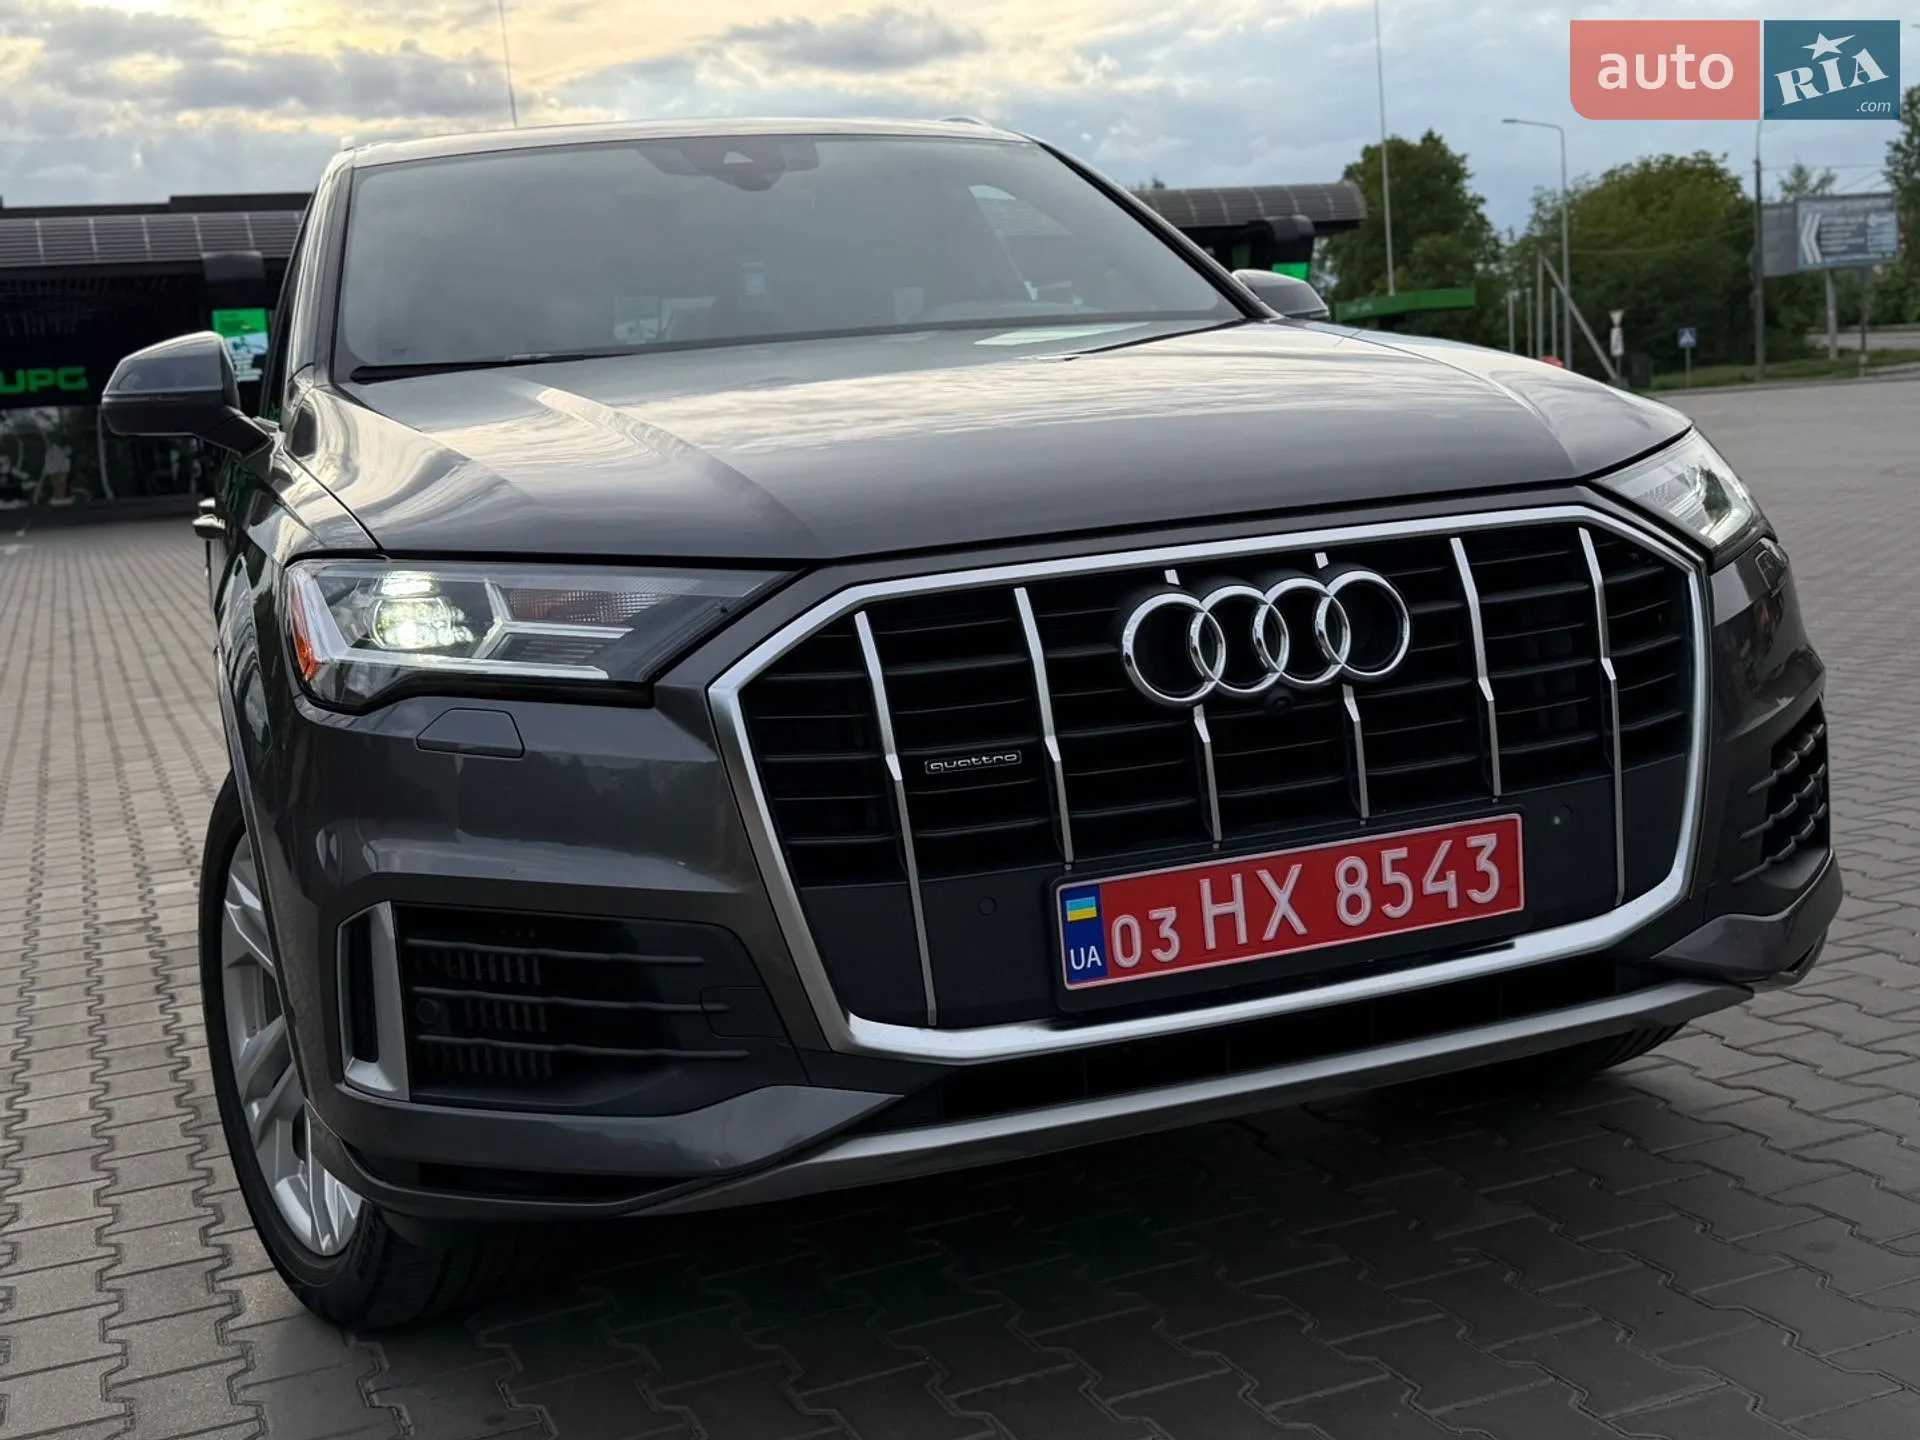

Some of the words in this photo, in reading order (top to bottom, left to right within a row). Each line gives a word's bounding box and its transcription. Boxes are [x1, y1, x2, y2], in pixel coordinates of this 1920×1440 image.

[0, 366, 88, 394] UPG
[929, 753, 1018, 772] quattro
[1111, 907, 1181, 969] 03
[1200, 864, 1308, 950] HX
[1334, 833, 1500, 927] 8543
[1070, 945, 1102, 971] UA
